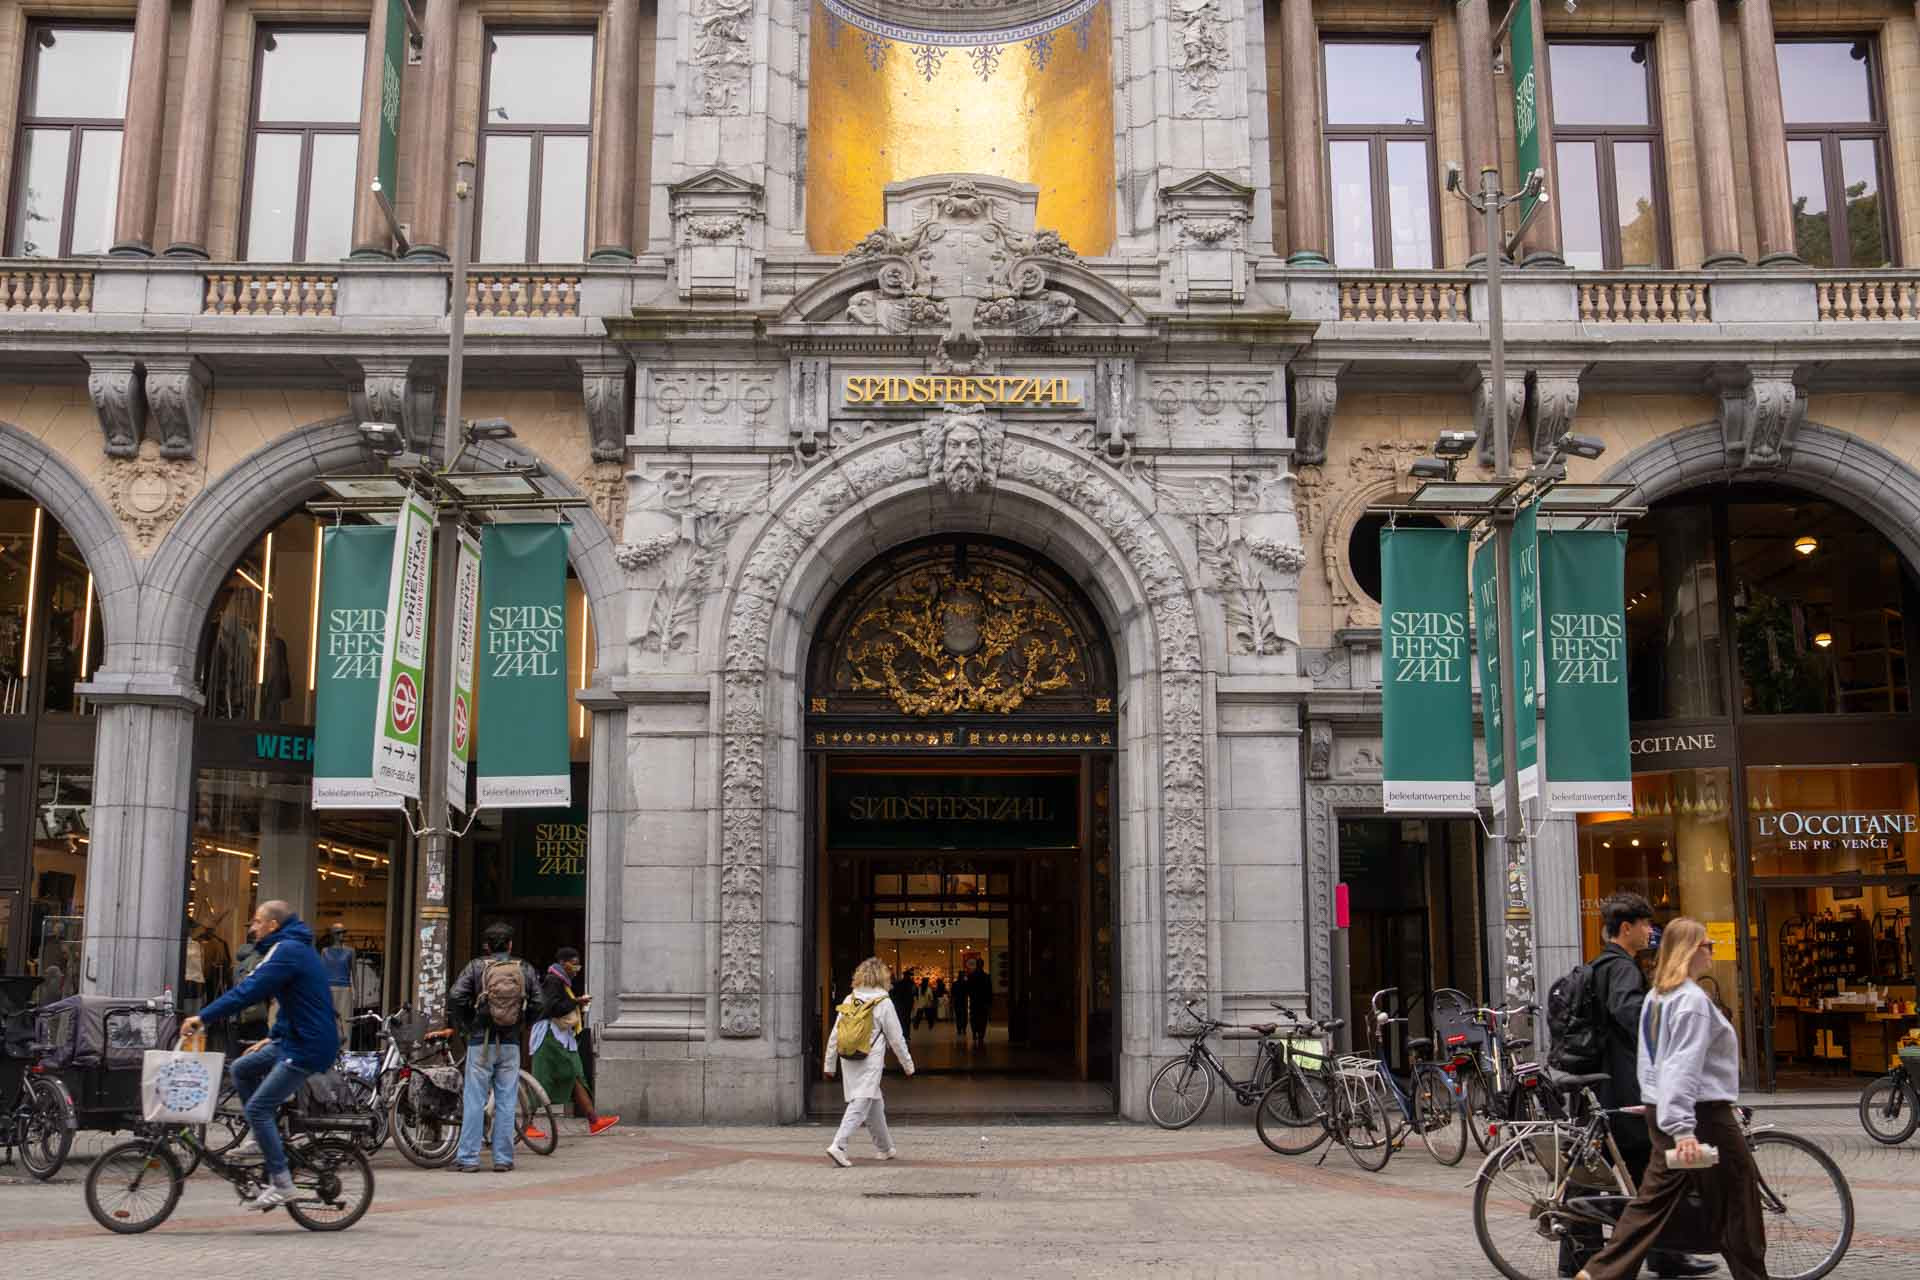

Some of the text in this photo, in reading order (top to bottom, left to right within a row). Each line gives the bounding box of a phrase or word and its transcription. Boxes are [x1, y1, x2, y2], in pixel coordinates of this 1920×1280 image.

[847, 376, 1080, 403] STADSFEESTZAAL
[405, 527, 424, 638] ORIENTAL
[488, 605, 563, 630] STADS
[1391, 611, 1464, 636] STADS
[1550, 614, 1622, 637] STADS
[488, 629, 563, 653] FEEST
[1391, 635, 1465, 659] FEEST
[1551, 637, 1622, 660] FEEST
[492, 653, 558, 676] ZAAL
[1396, 659, 1461, 682] ZAAL
[1556, 660, 1619, 683] ZAAL
[848, 795, 1055, 821] STADSFEESTZAAL
[536, 823, 588, 840] STADS
[1758, 811, 1919, 836] L'OCCITANE
[536, 840, 586, 857] FEEST
[1789, 838, 1889, 850] EN PRVENCE
[537, 857, 585, 874] ZAAL
